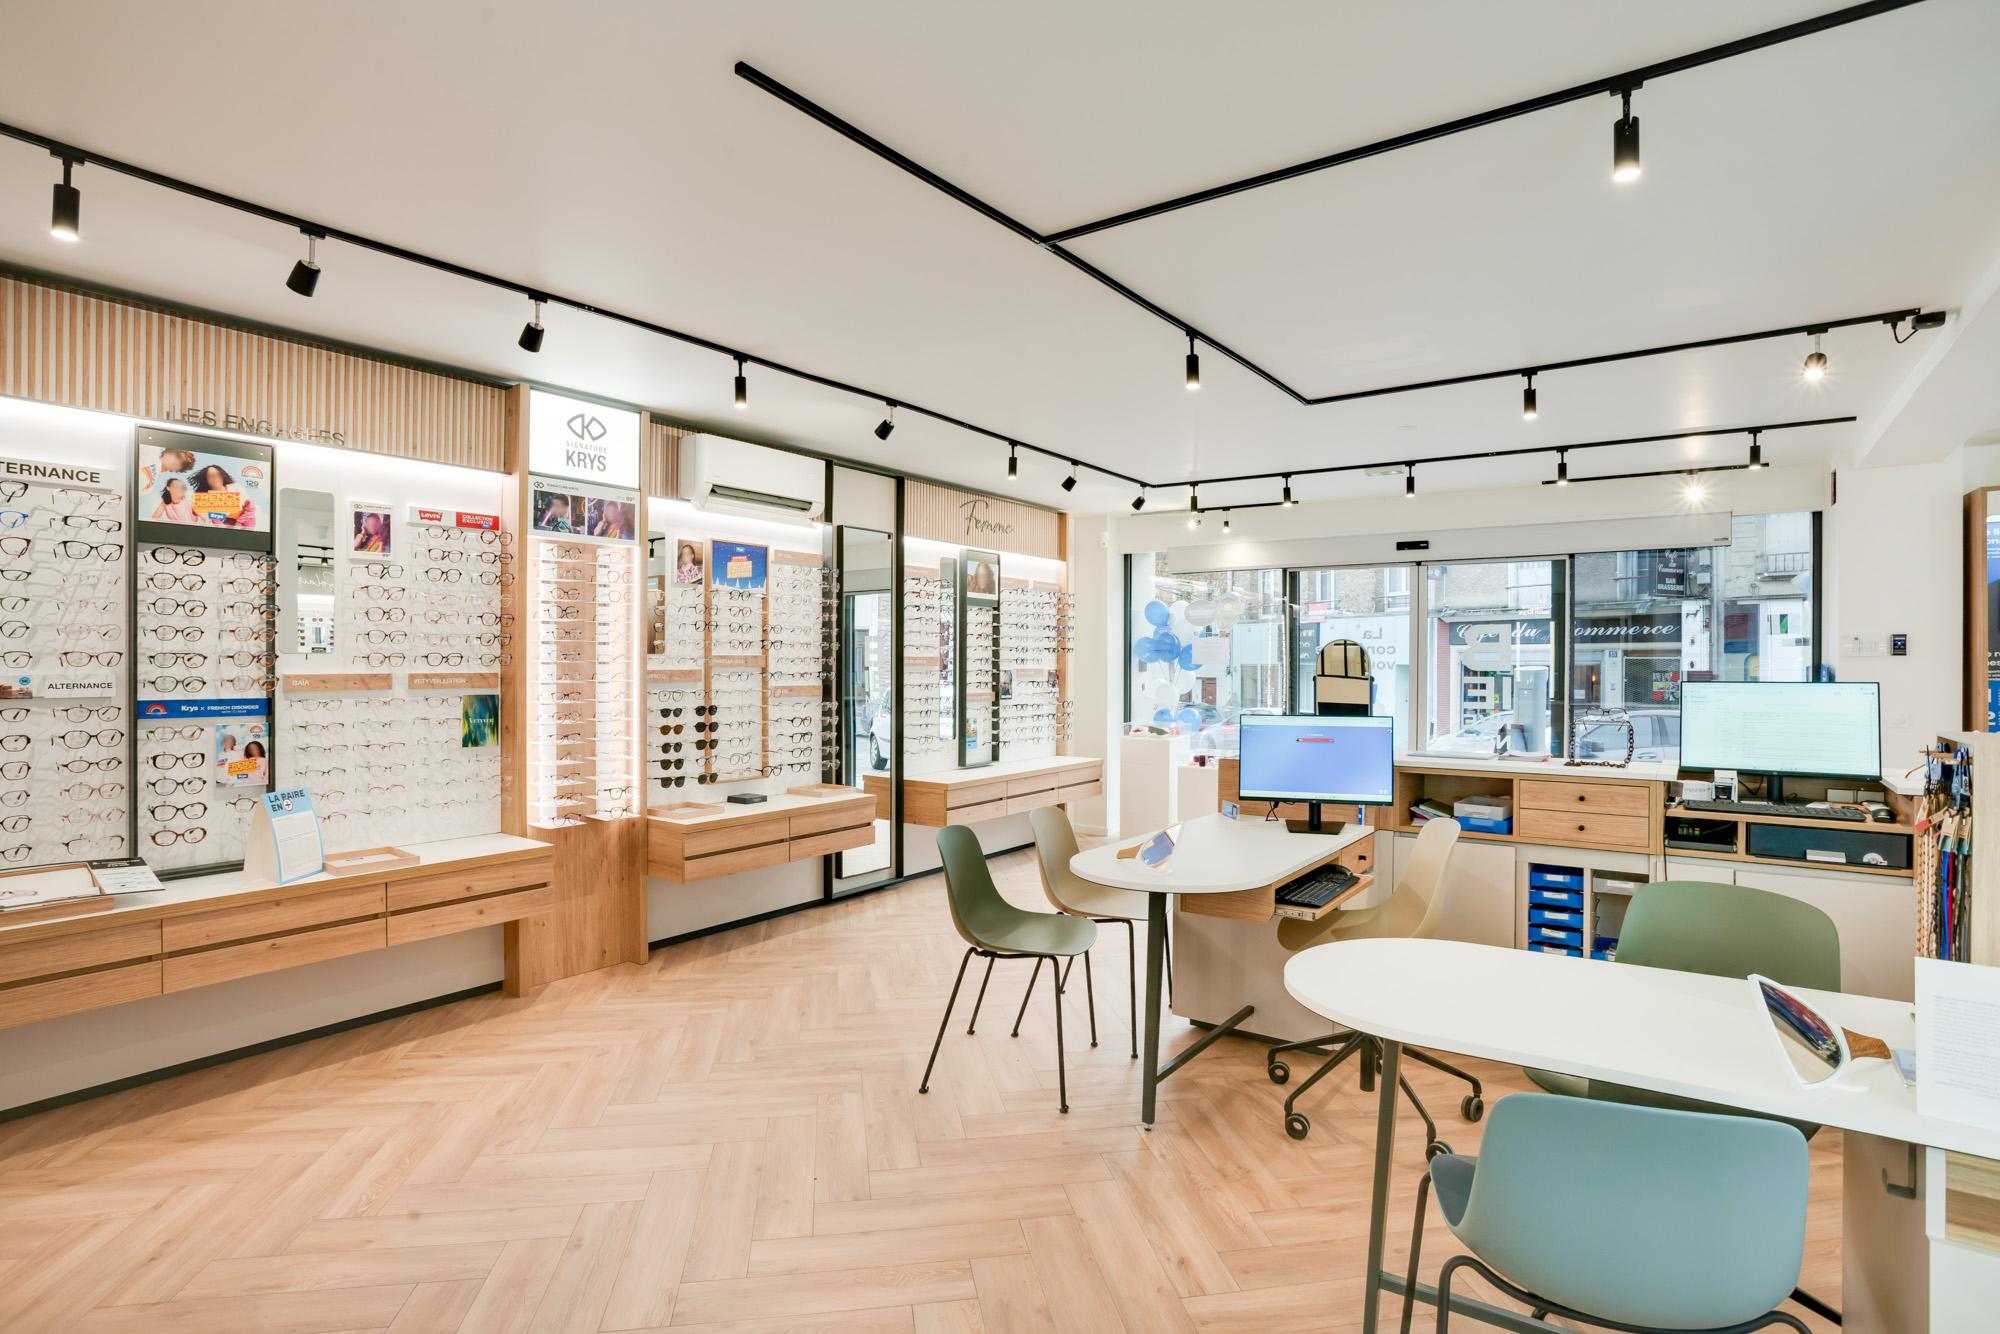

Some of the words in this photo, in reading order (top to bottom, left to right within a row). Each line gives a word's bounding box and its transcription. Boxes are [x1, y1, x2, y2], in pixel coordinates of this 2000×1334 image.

[566, 440, 607, 453] SIGNATURE
[566, 449, 607, 472] KRYS
[193, 493, 240, 501] FRENCH
[1574, 621, 1680, 637] ommerce
[47, 682, 113, 690] ALTERNANCE
[268, 794, 280, 803] LA
[281, 789, 305, 801] PAIRE
[271, 803, 284, 812] EN
